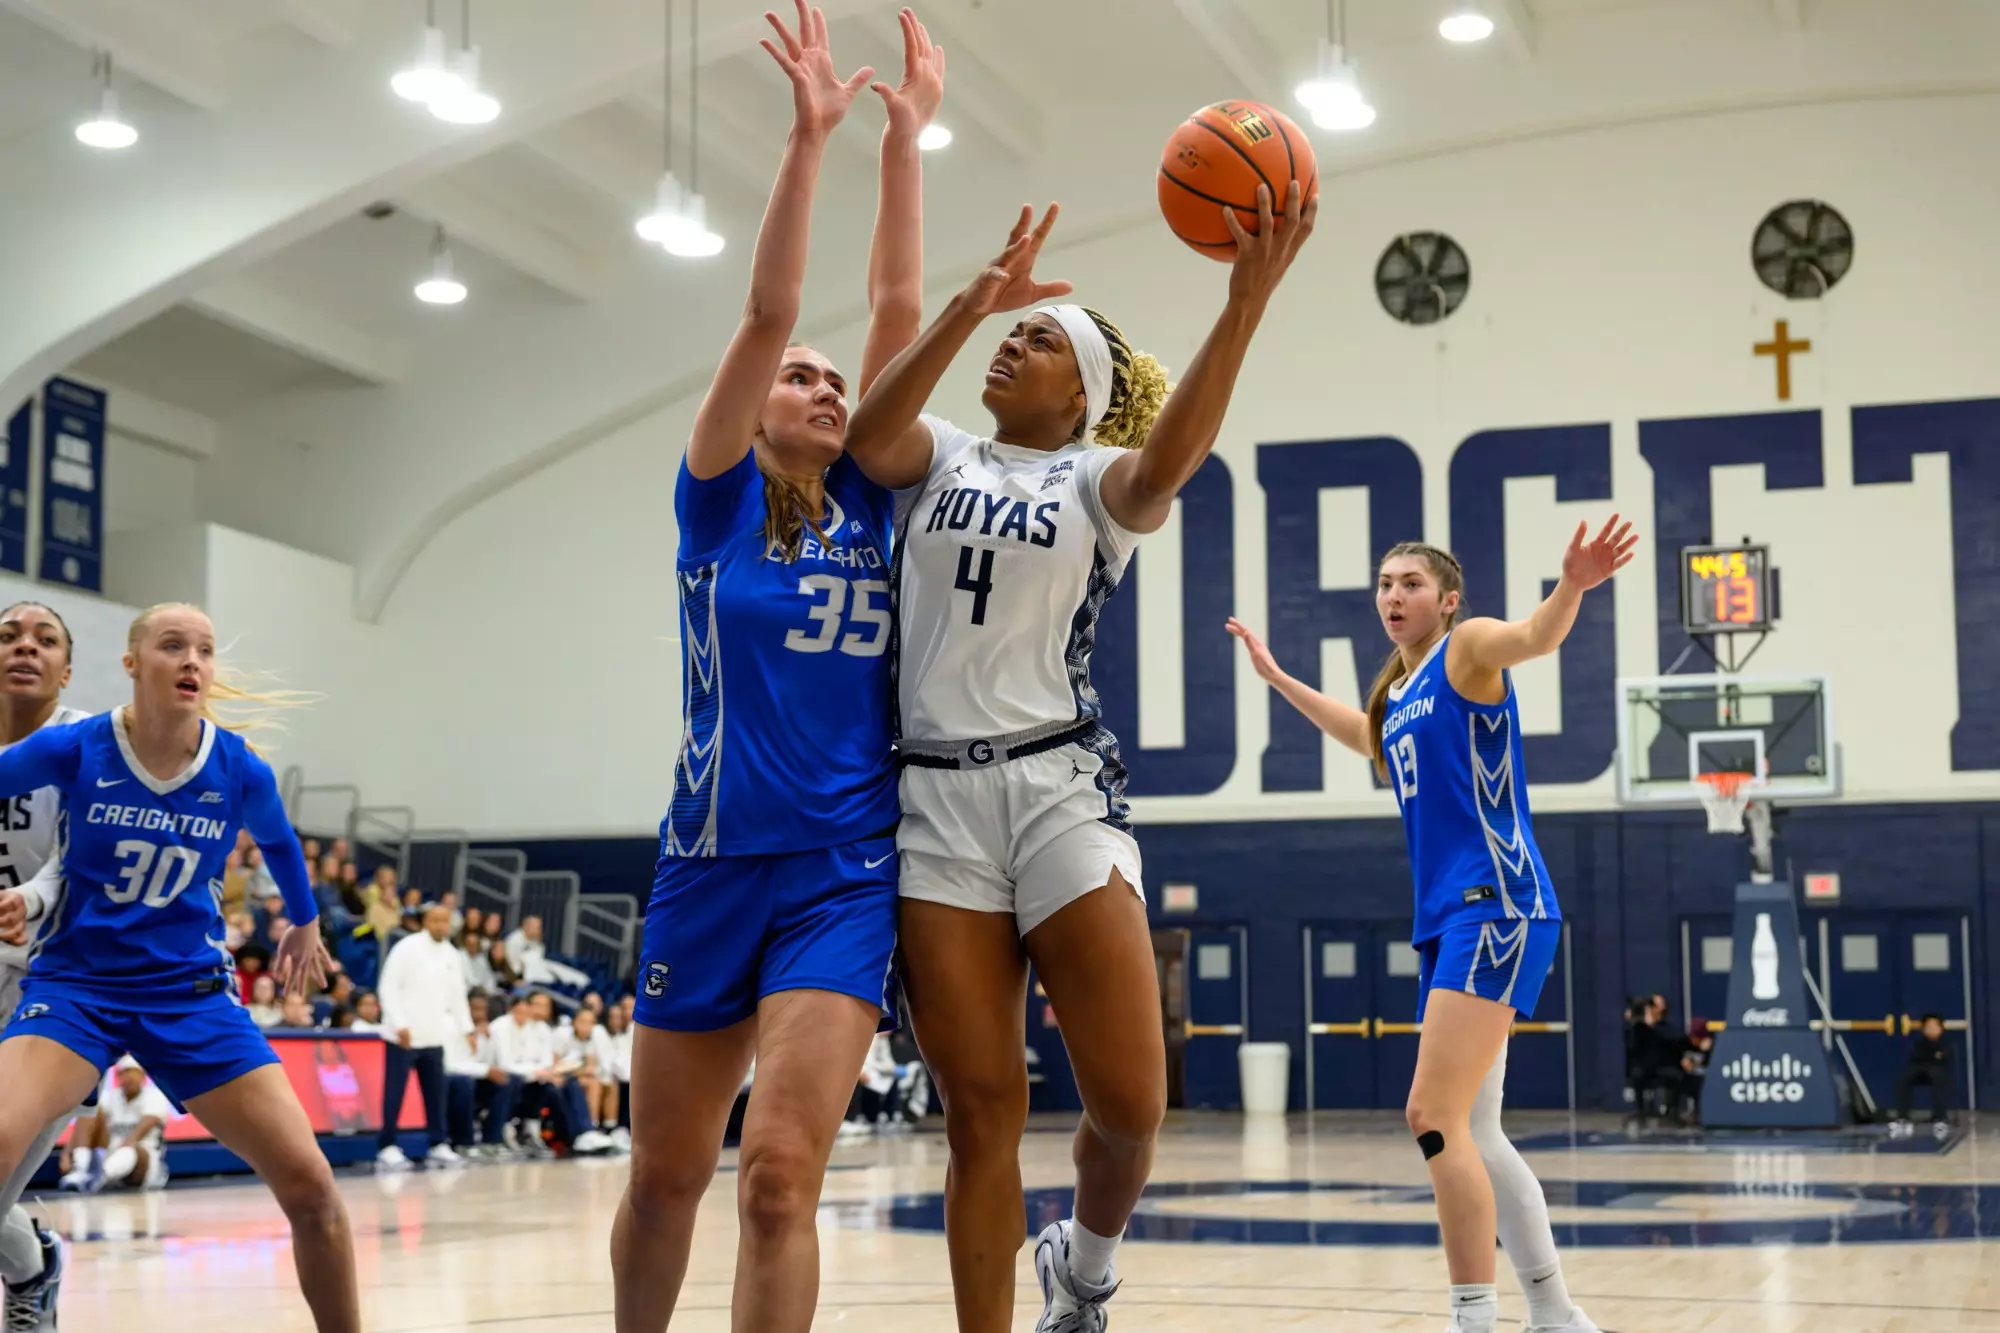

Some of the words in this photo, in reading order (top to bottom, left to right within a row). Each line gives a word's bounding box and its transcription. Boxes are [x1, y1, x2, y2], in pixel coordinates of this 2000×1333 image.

[926, 487, 1060, 548] HOYAS
[954, 545, 994, 626] 4
[1692, 551, 1746, 579] 44.5
[783, 573, 892, 657] 35
[1715, 577, 1756, 623] 13
[967, 739, 996, 765] G
[1388, 733, 1418, 806] 13
[86, 802, 227, 840] CREIGHTON
[104, 839, 202, 908] 30
